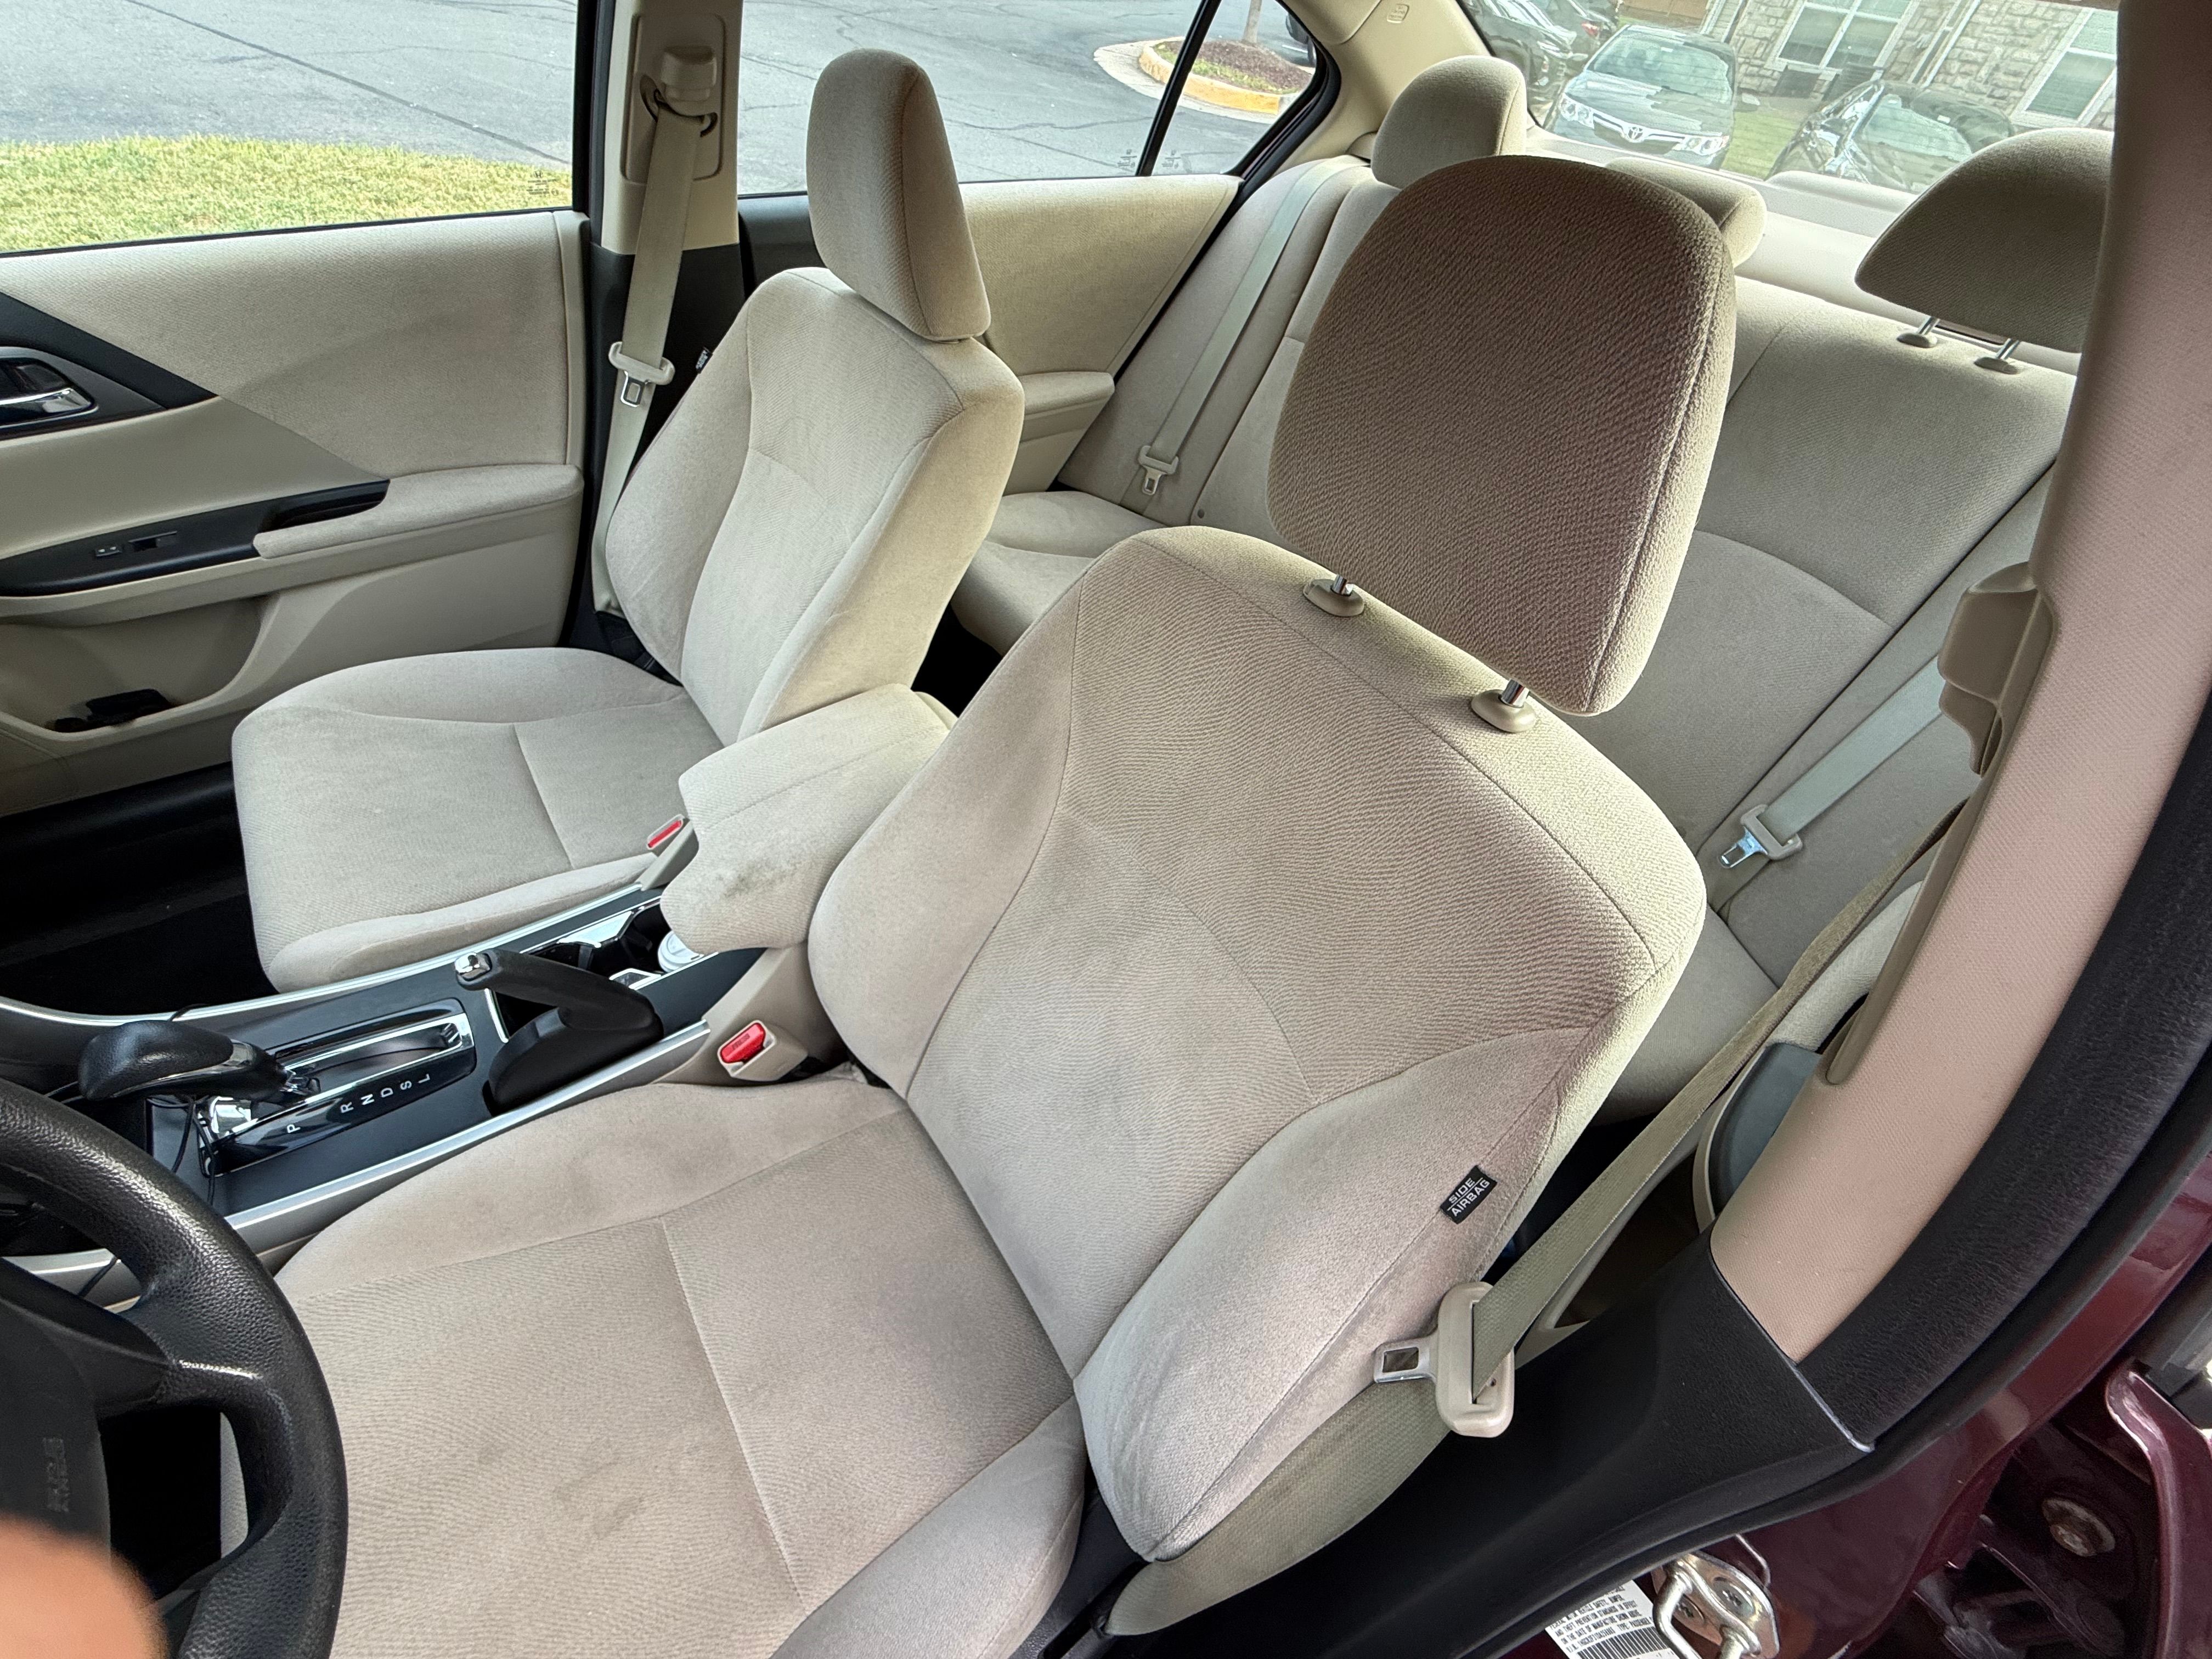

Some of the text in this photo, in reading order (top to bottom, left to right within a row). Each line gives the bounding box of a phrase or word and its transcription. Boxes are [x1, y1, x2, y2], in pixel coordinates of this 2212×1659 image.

[286, 1073, 431, 1134] P R N D S L
[1448, 1177, 1475, 1204] SIDE
[1451, 1179, 1491, 1217] AIRBAG
[1563, 1622, 1576, 1632] THEFT
[1575, 1612, 1598, 1626] PREVENTION
[1623, 1600, 1638, 1609] EFFECT
[1575, 1628, 1587, 1637] DATE
